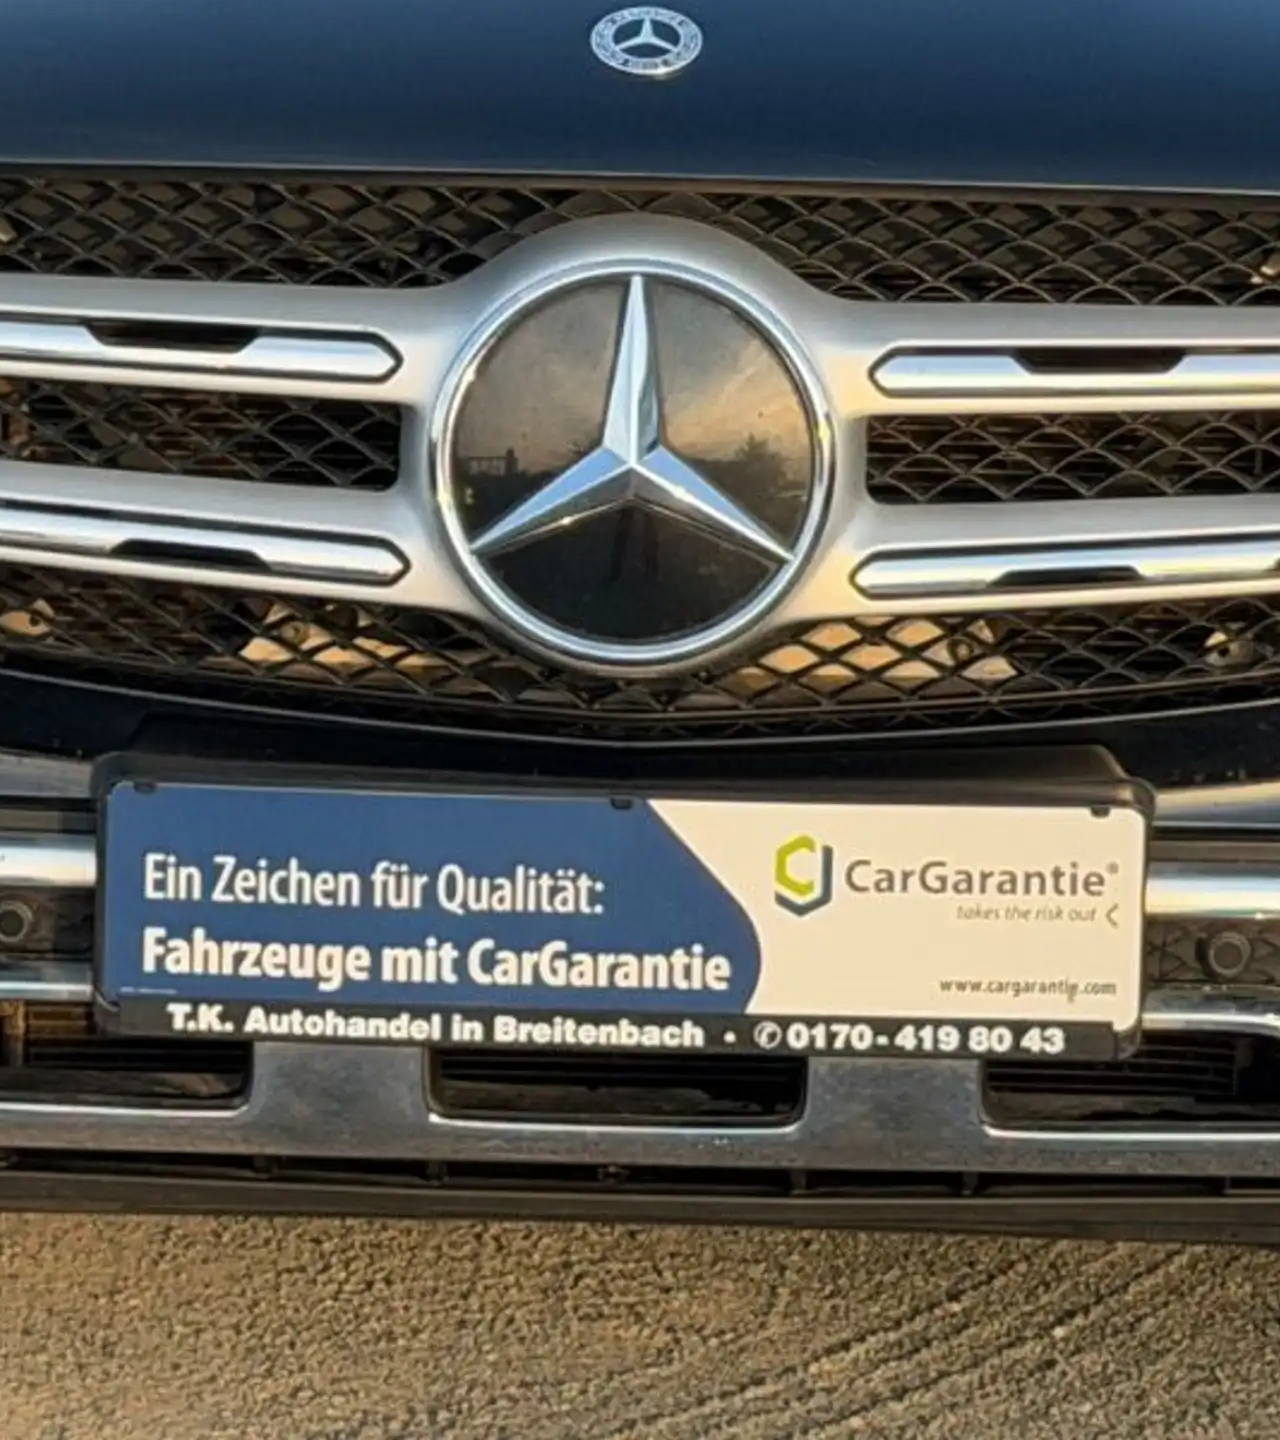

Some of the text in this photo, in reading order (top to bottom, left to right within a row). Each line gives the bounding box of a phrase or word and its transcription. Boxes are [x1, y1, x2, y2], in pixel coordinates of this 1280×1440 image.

[143, 851, 605, 915] Ein Zeichen für Qualität:
[956, 903, 1098, 922] takes the risk out
[142, 926, 732, 992] Fahrzeuge mit CarGarantie
[166, 1002, 706, 1047] T.K. Autohandel in Breitenbach
[967, 1025, 1014, 1053] 80
[1020, 1026, 1066, 1054] 43
